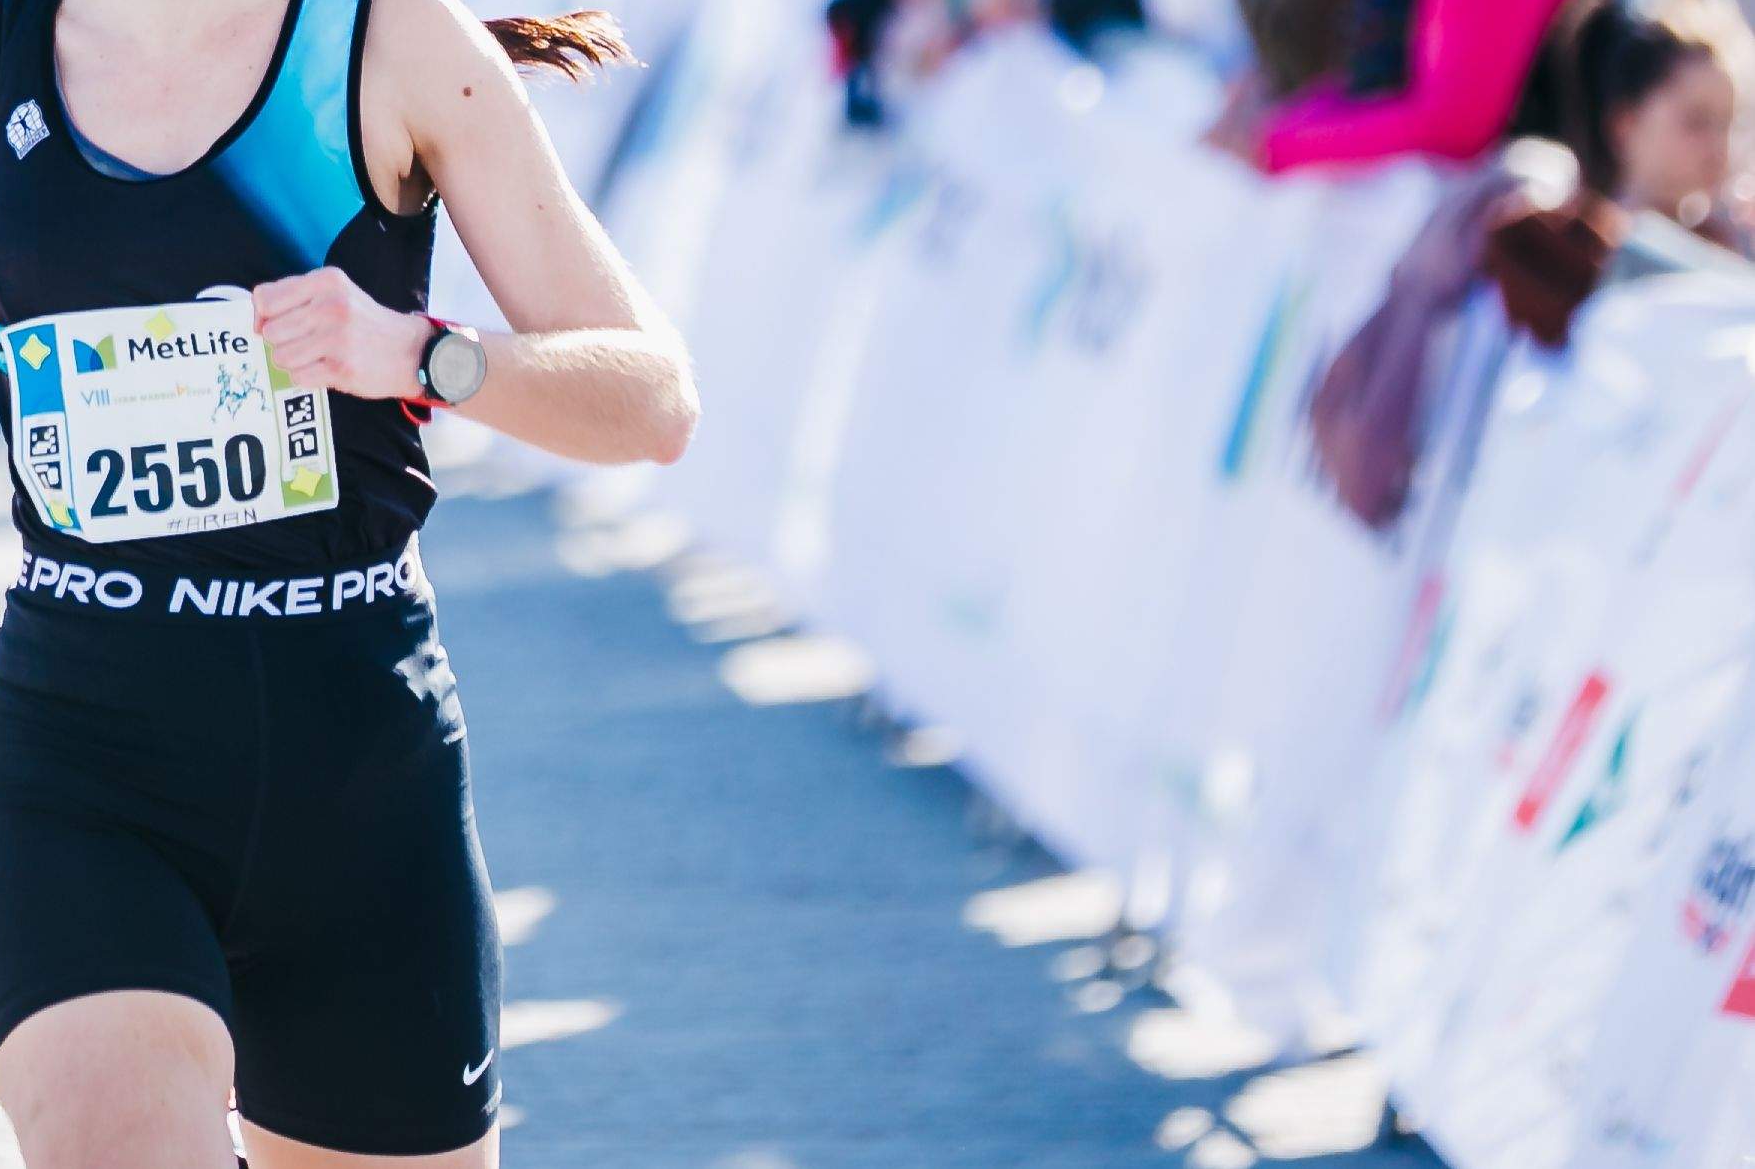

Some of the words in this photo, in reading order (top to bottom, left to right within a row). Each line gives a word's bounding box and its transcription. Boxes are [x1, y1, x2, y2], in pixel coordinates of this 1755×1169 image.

[128, 330, 249, 362] MetLife
[80, 388, 111, 407] VIII
[86, 433, 266, 519] 2550
[169, 577, 324, 617] NIKE
[332, 550, 419, 611] PRO
